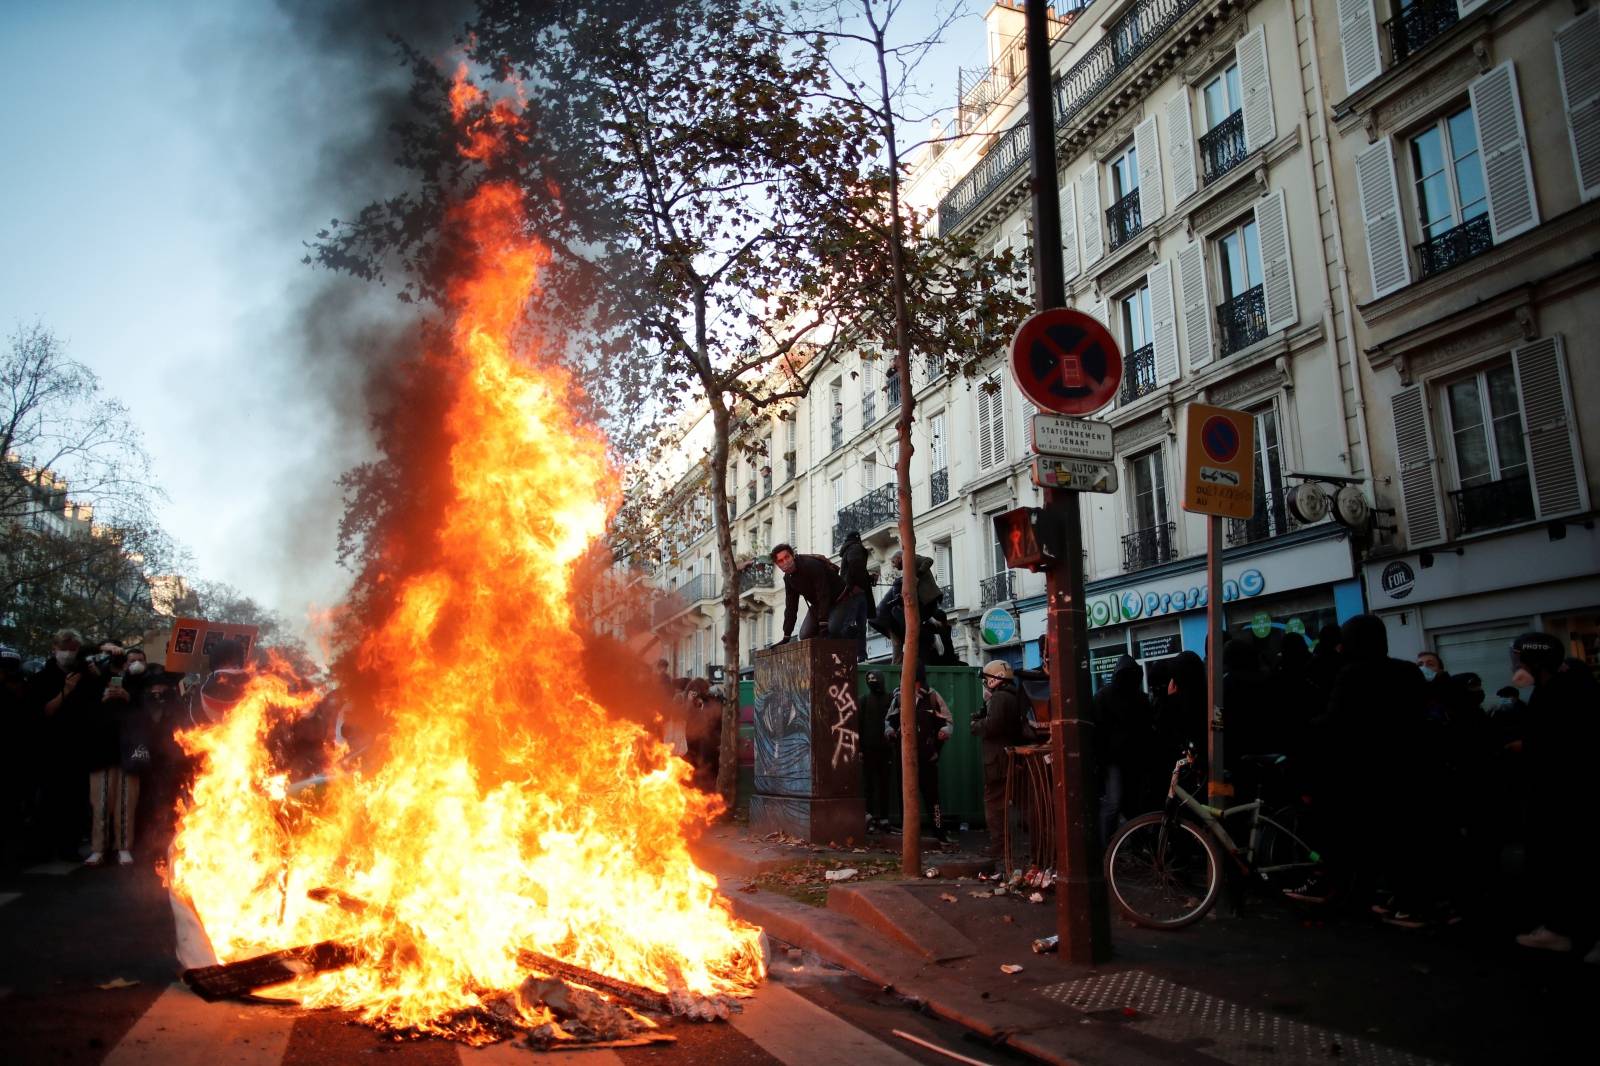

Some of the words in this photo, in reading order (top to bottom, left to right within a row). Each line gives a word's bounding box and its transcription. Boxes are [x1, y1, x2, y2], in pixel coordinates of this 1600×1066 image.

[1055, 420, 1079, 430] ARRÊT
[1081, 423, 1092, 431] OU
[1041, 426, 1106, 441] STATIONNEMENT
[1059, 437, 1089, 447] GÊNANT
[1196, 496, 1208, 505] AU
[1521, 642, 1549, 651] PHOTO
